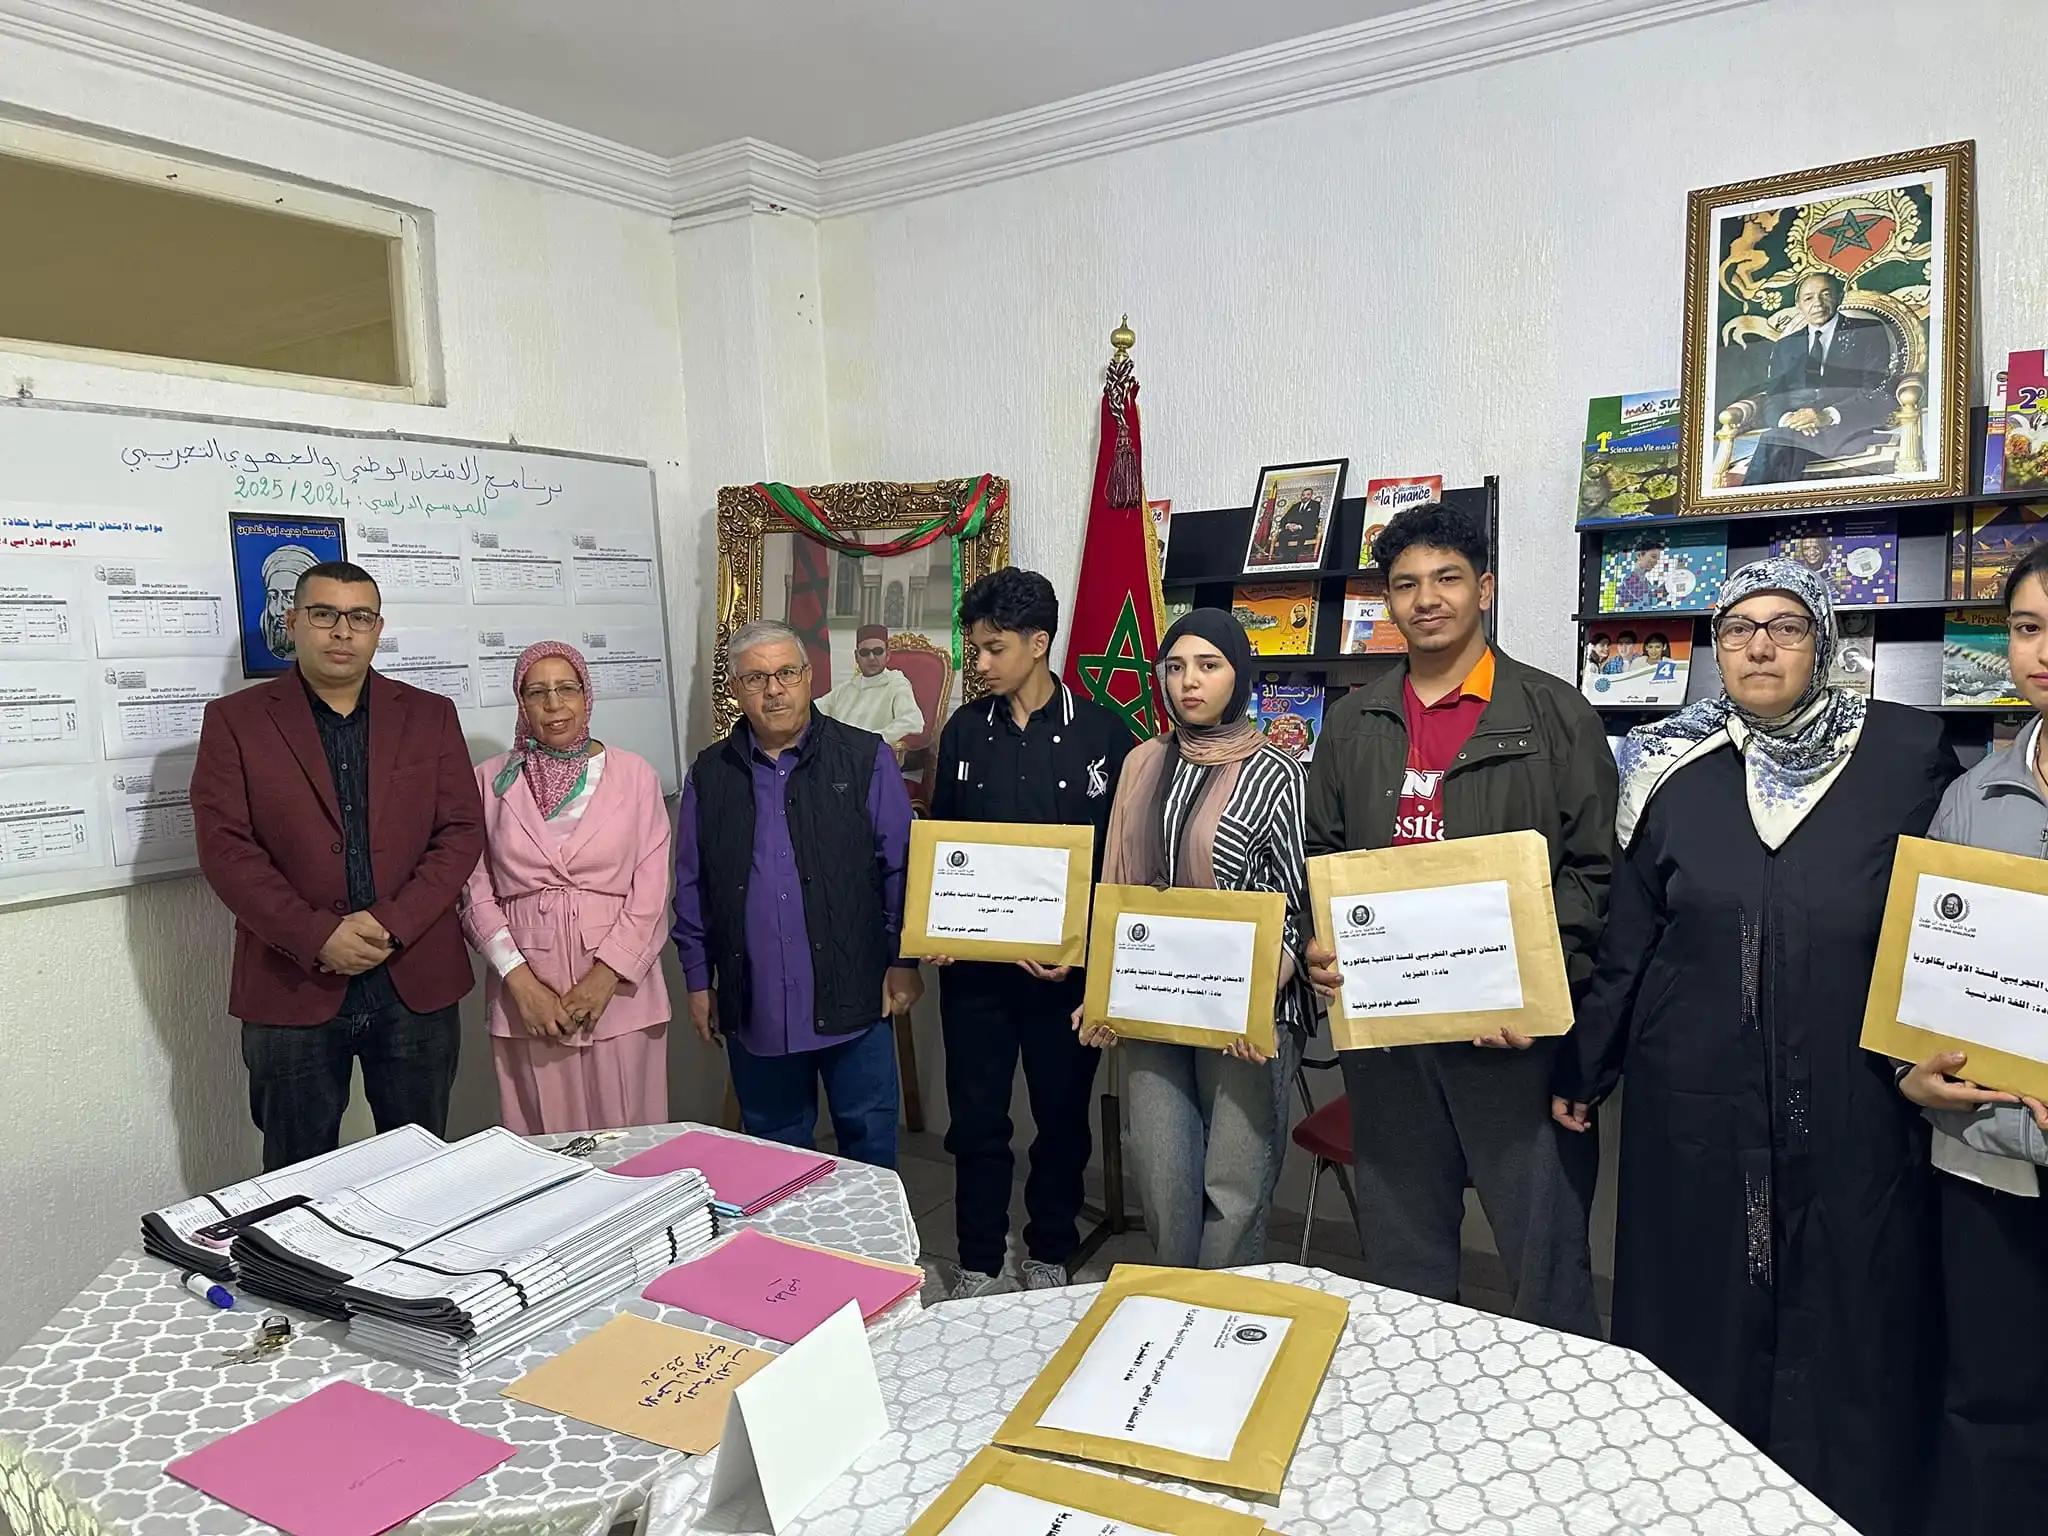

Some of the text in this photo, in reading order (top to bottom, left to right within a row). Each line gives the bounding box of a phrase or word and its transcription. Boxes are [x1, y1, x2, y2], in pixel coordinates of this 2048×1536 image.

[121, 437, 222, 473] التجريبي
[1609, 445, 1633, 454] Science
[1643, 443, 1655, 452] Vie
[223, 445, 337, 476] والجهوي
[337, 455, 408, 485] الوطني
[411, 455, 480, 485] الامتحان
[425, 495, 487, 519] للموسم
[1360, 609, 1374, 617] PC
[1658, 663, 1671, 677] 4
[1913, 952, 1945, 968] بكالوريا
[1974, 967, 1999, 979] للسنة
[2000, 975, 2044, 989] التجريبي
[1964, 987, 2006, 1003] الفرنسية
